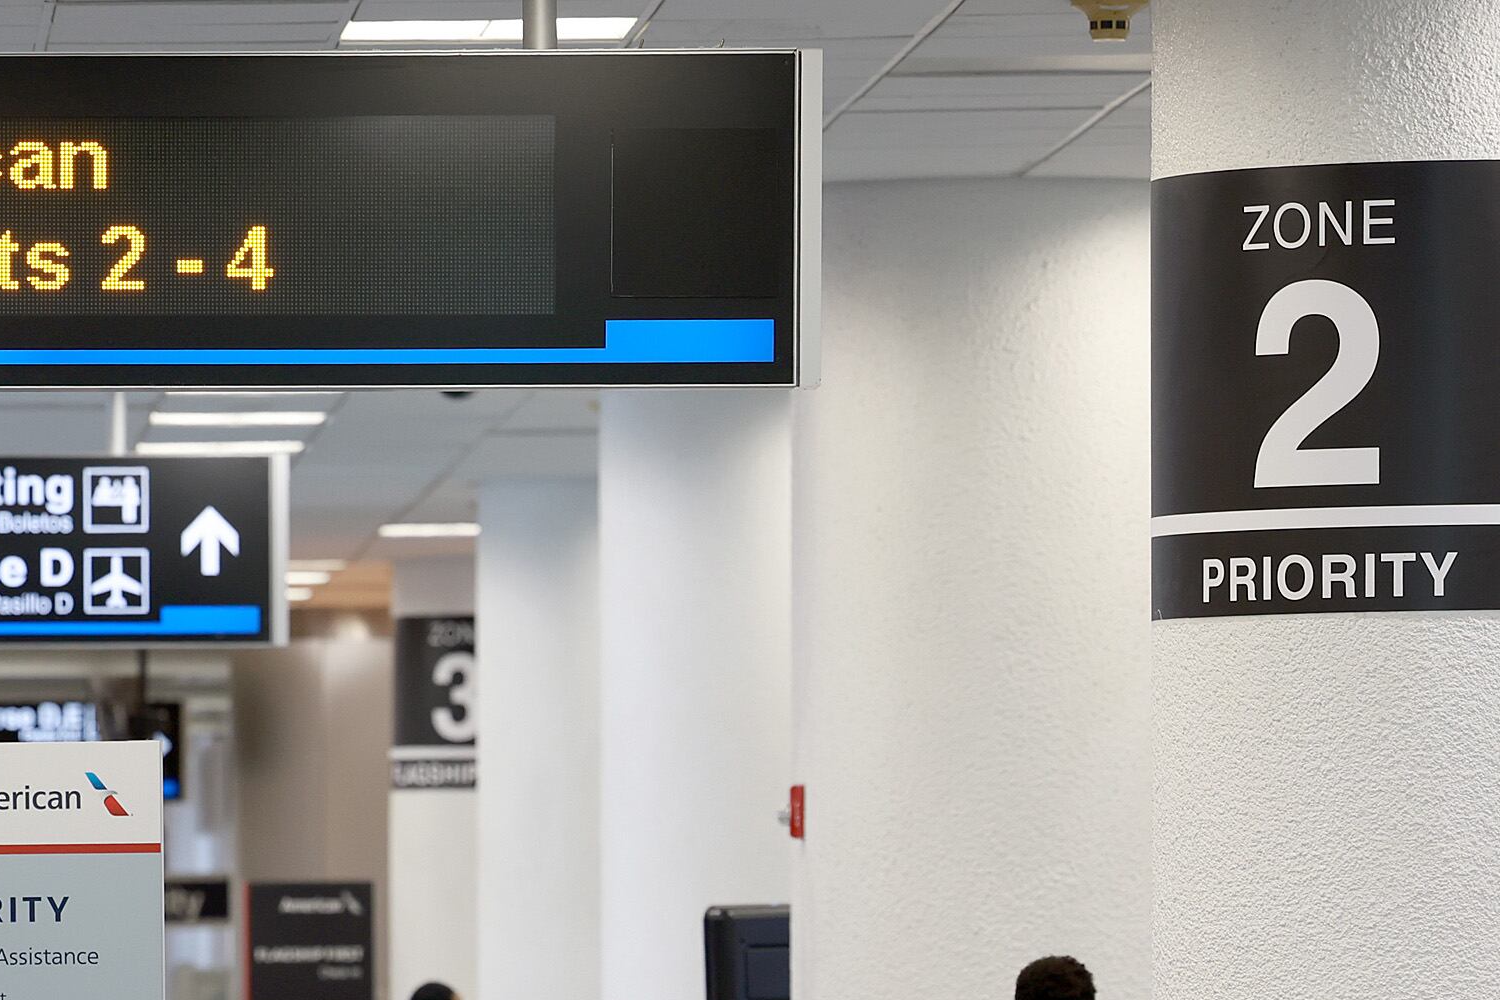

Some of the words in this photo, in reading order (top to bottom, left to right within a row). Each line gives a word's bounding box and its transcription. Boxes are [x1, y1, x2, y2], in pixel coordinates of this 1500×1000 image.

[1243, 200, 1395, 250] ZONE
[102, 226, 144, 292] 2
[177, 260, 203, 273] -
[227, 226, 274, 290] 4
[1254, 280, 1379, 488] 2
[40, 548, 74, 587] D
[1203, 552, 1458, 602] PRIORITY
[55, 592, 74, 615] D
[430, 649, 475, 744] 3
